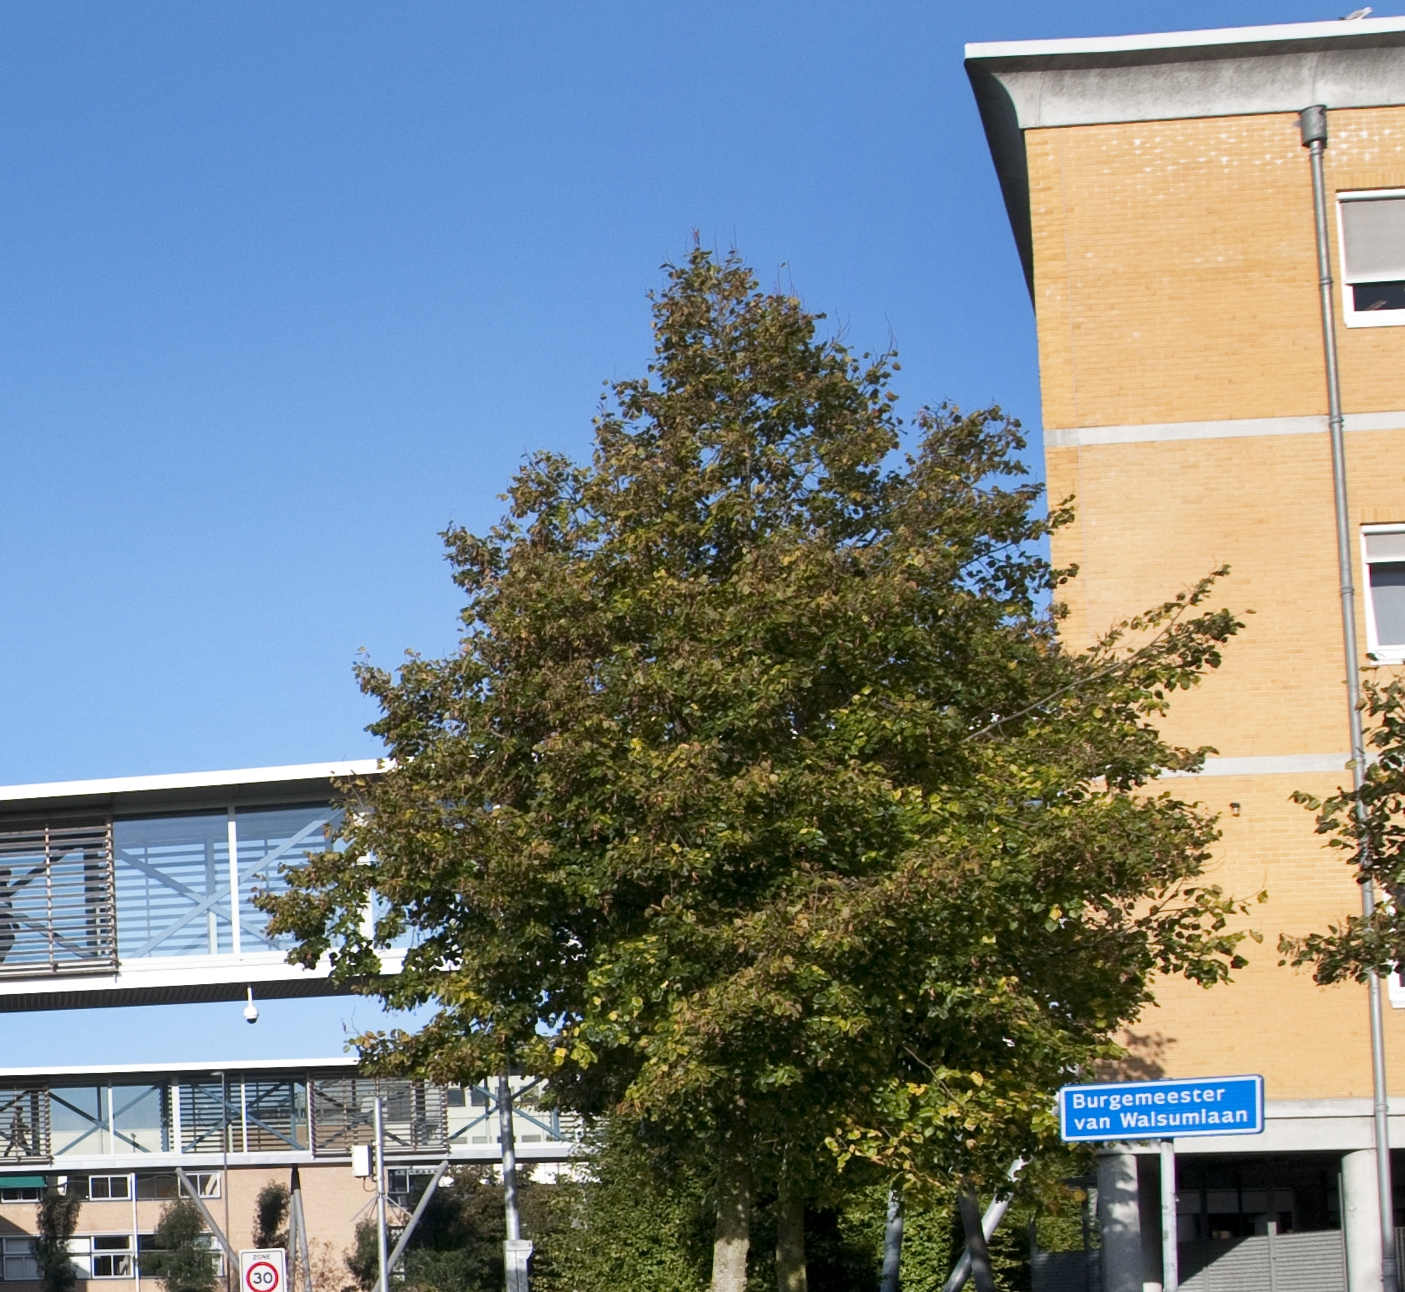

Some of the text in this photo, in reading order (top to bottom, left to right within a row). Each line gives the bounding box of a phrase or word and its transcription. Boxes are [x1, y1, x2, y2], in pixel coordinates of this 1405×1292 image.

[1072, 1088, 1226, 1110] Burgemeester
[1074, 1109, 1248, 1130] van Walsumlaan
[253, 1271, 273, 1284] 30
